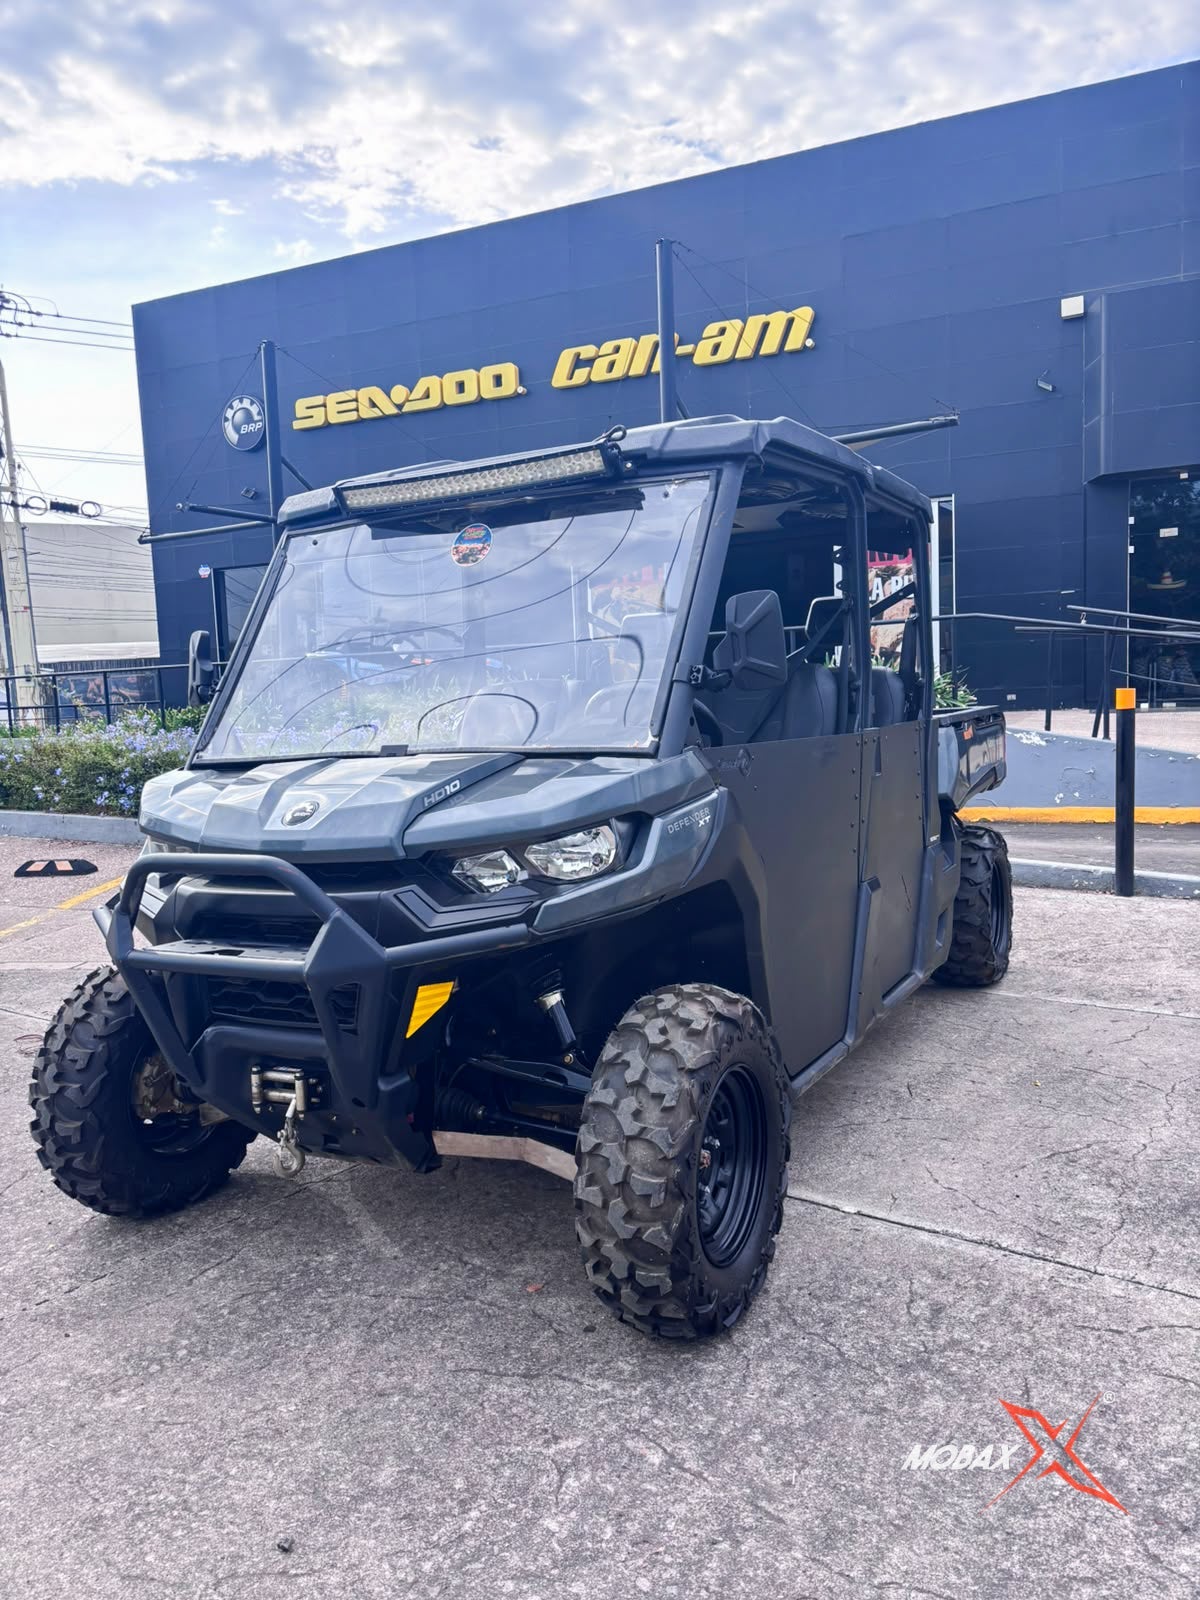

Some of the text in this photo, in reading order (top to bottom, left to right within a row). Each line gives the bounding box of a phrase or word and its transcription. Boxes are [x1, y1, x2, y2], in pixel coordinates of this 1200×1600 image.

[240, 421, 263, 435] BRP
[423, 779, 461, 807] HD10
[667, 807, 711, 834] DEFENDER
[698, 815, 711, 828] XT
